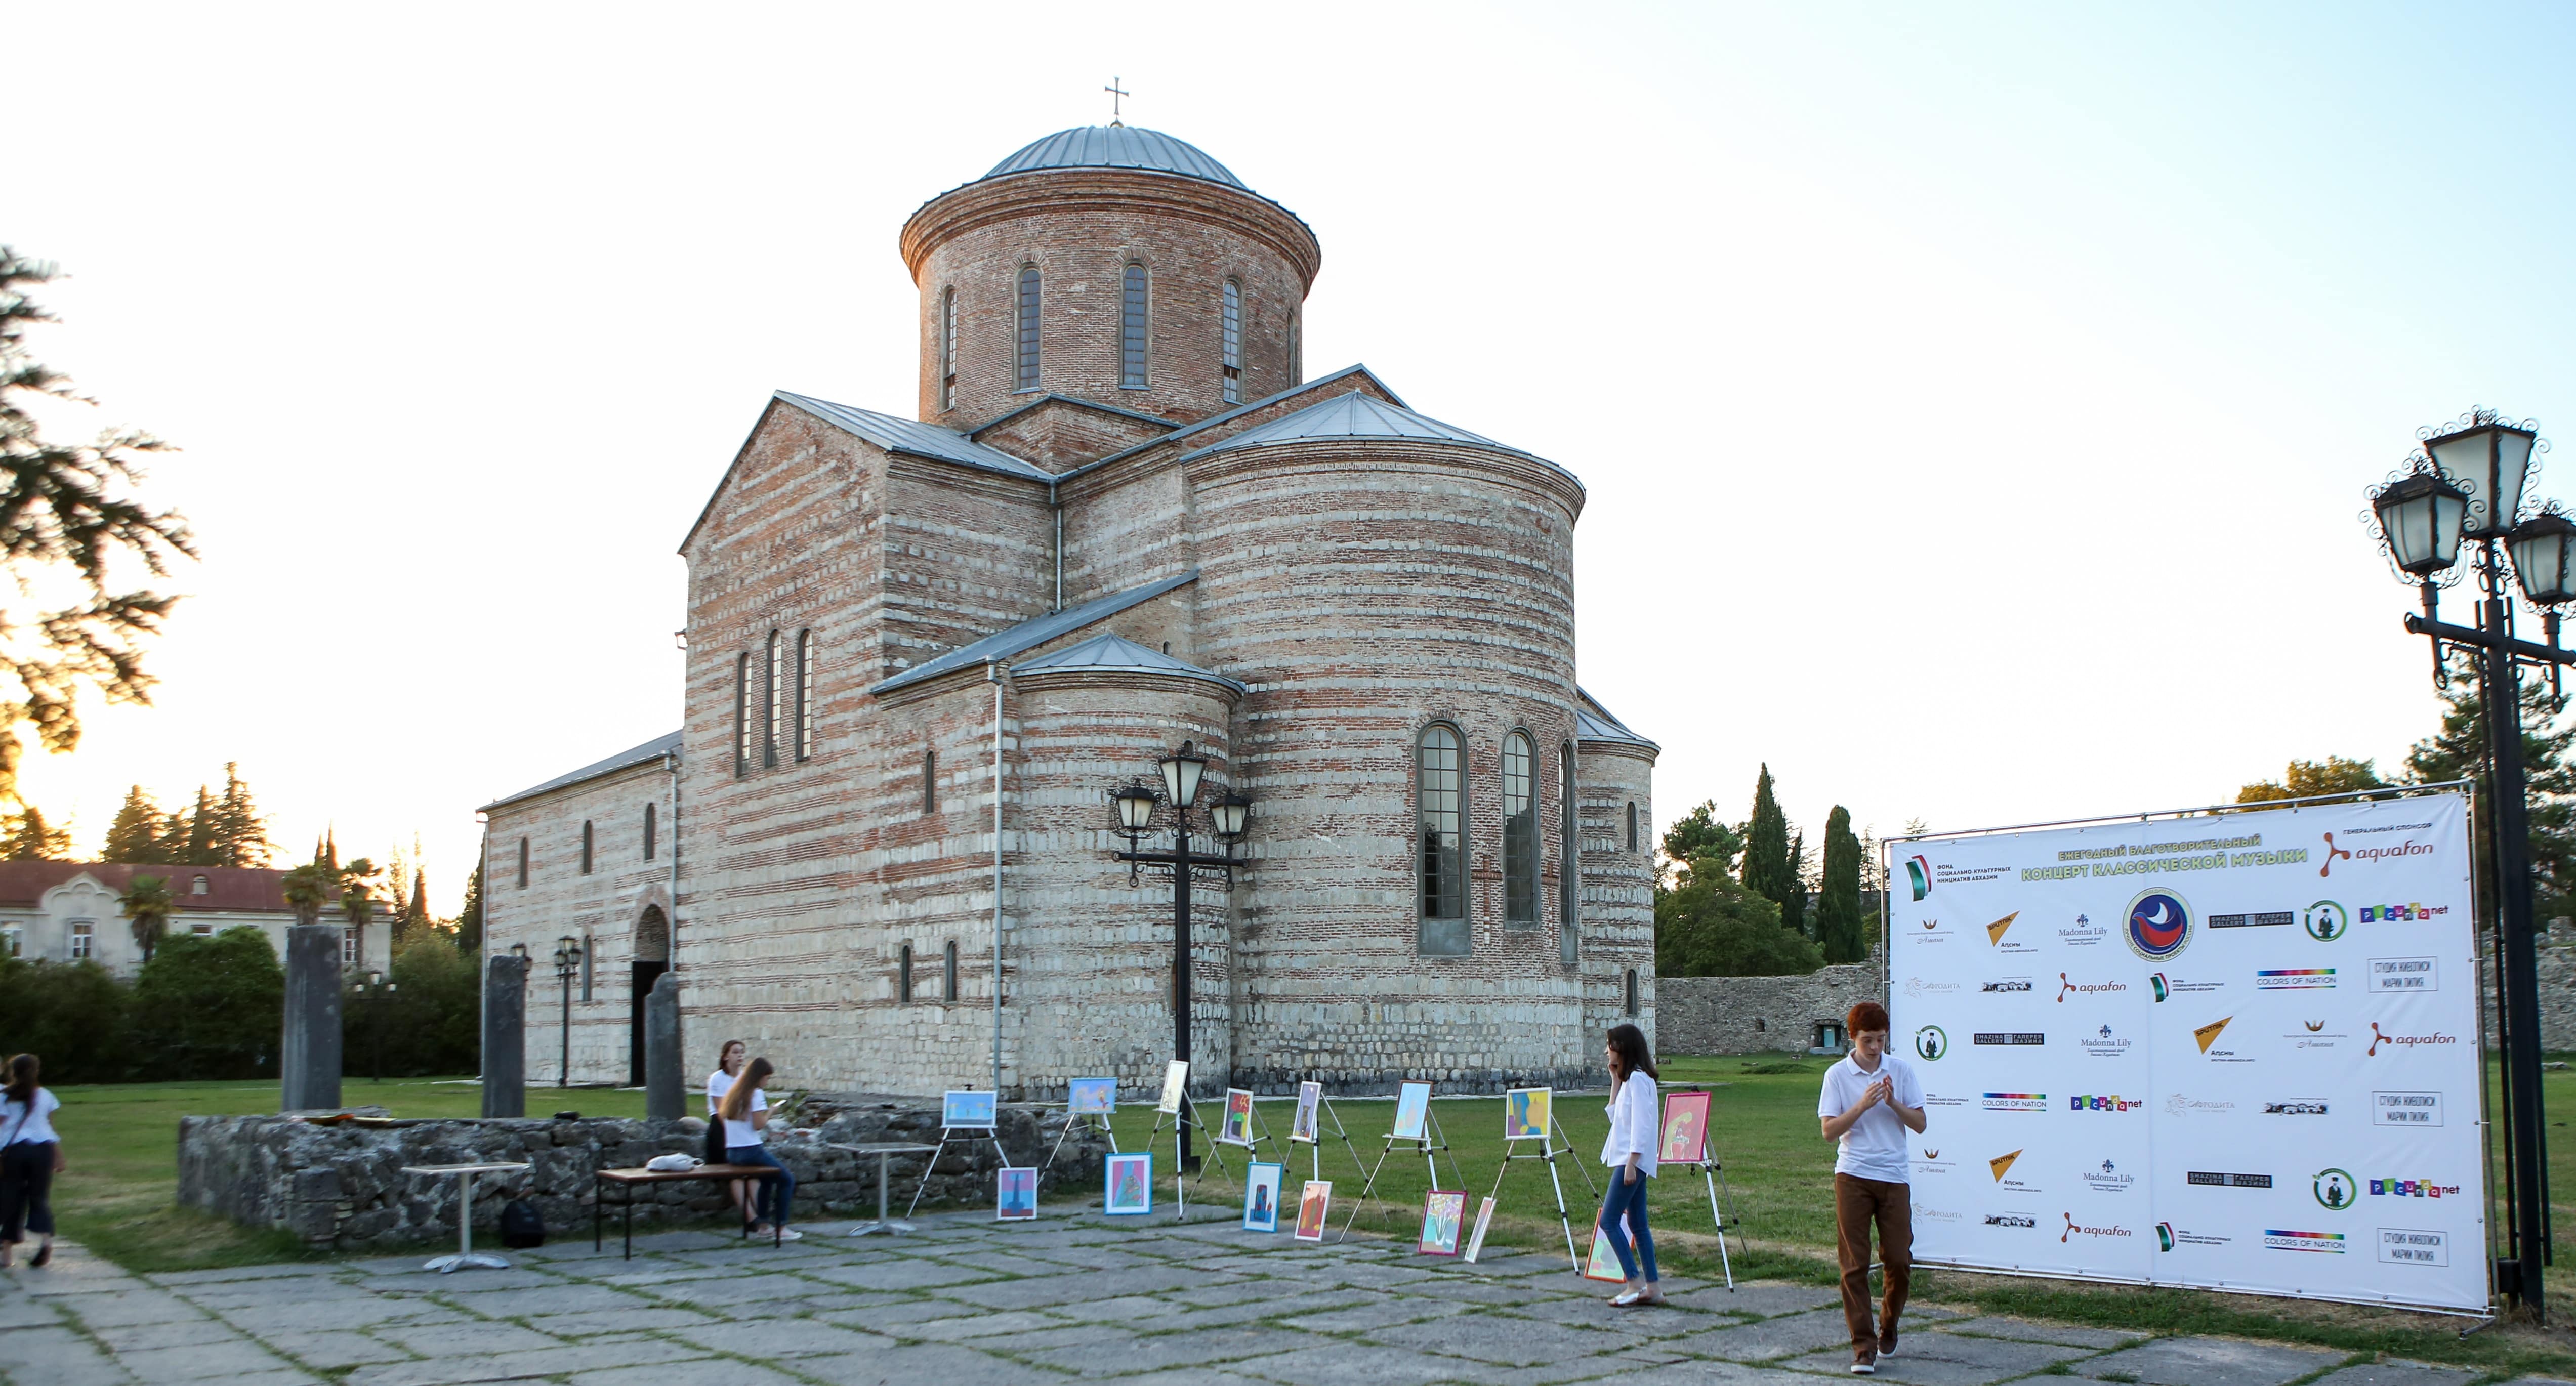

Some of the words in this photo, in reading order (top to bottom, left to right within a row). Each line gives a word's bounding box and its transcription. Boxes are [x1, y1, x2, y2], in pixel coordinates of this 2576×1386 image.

[2343, 825, 2395, 834] ГЕНЕРАЛЬНЫЙ
[2396, 822, 2433, 831] СПОНСОР
[2058, 845, 2126, 861] ЕЖЕГОДНЫЙ
[2129, 833, 2262, 856] БЛАГОТВОРИТЕЛЬНЫЙ
[2356, 839, 2433, 863] aquafon
[2022, 864, 2089, 881] КОНЦЕРТ
[2093, 851, 2226, 876] КЛАССИЧЕСКОЙ
[2231, 849, 2308, 867] МУЗЫКИ
[1988, 916, 2012, 931] SPUTNIK
[2058, 928, 2092, 936] Madonna
[2094, 927, 2107, 936] Lily
[2375, 962, 2397, 973] СТУДИЯ
[2080, 980, 2126, 995] aquafon
[2196, 1022, 2224, 1036] SPUTNIK
[2117, 1038, 2132, 1048] Lily
[2396, 1032, 2456, 1048] aquafon
[2379, 1096, 2402, 1106] СТУДИЯ
[2403, 1096, 2436, 1106] ЖИВОПИСИ
[2387, 1111, 2407, 1121] МАРИИ
[1991, 1154, 2015, 1166] SPUTNIK
[2083, 1173, 2117, 1182] Madonna
[2120, 1175, 2134, 1184] Lily
[2084, 1226, 2131, 1238] aquafon
[2264, 1238, 2297, 1246] COLORS
[2384, 1233, 2406, 1243] СТУДИЯ
[2408, 1234, 2440, 1246] ЖИВОПИСИ
[2392, 1249, 2413, 1259] МАРИИ
